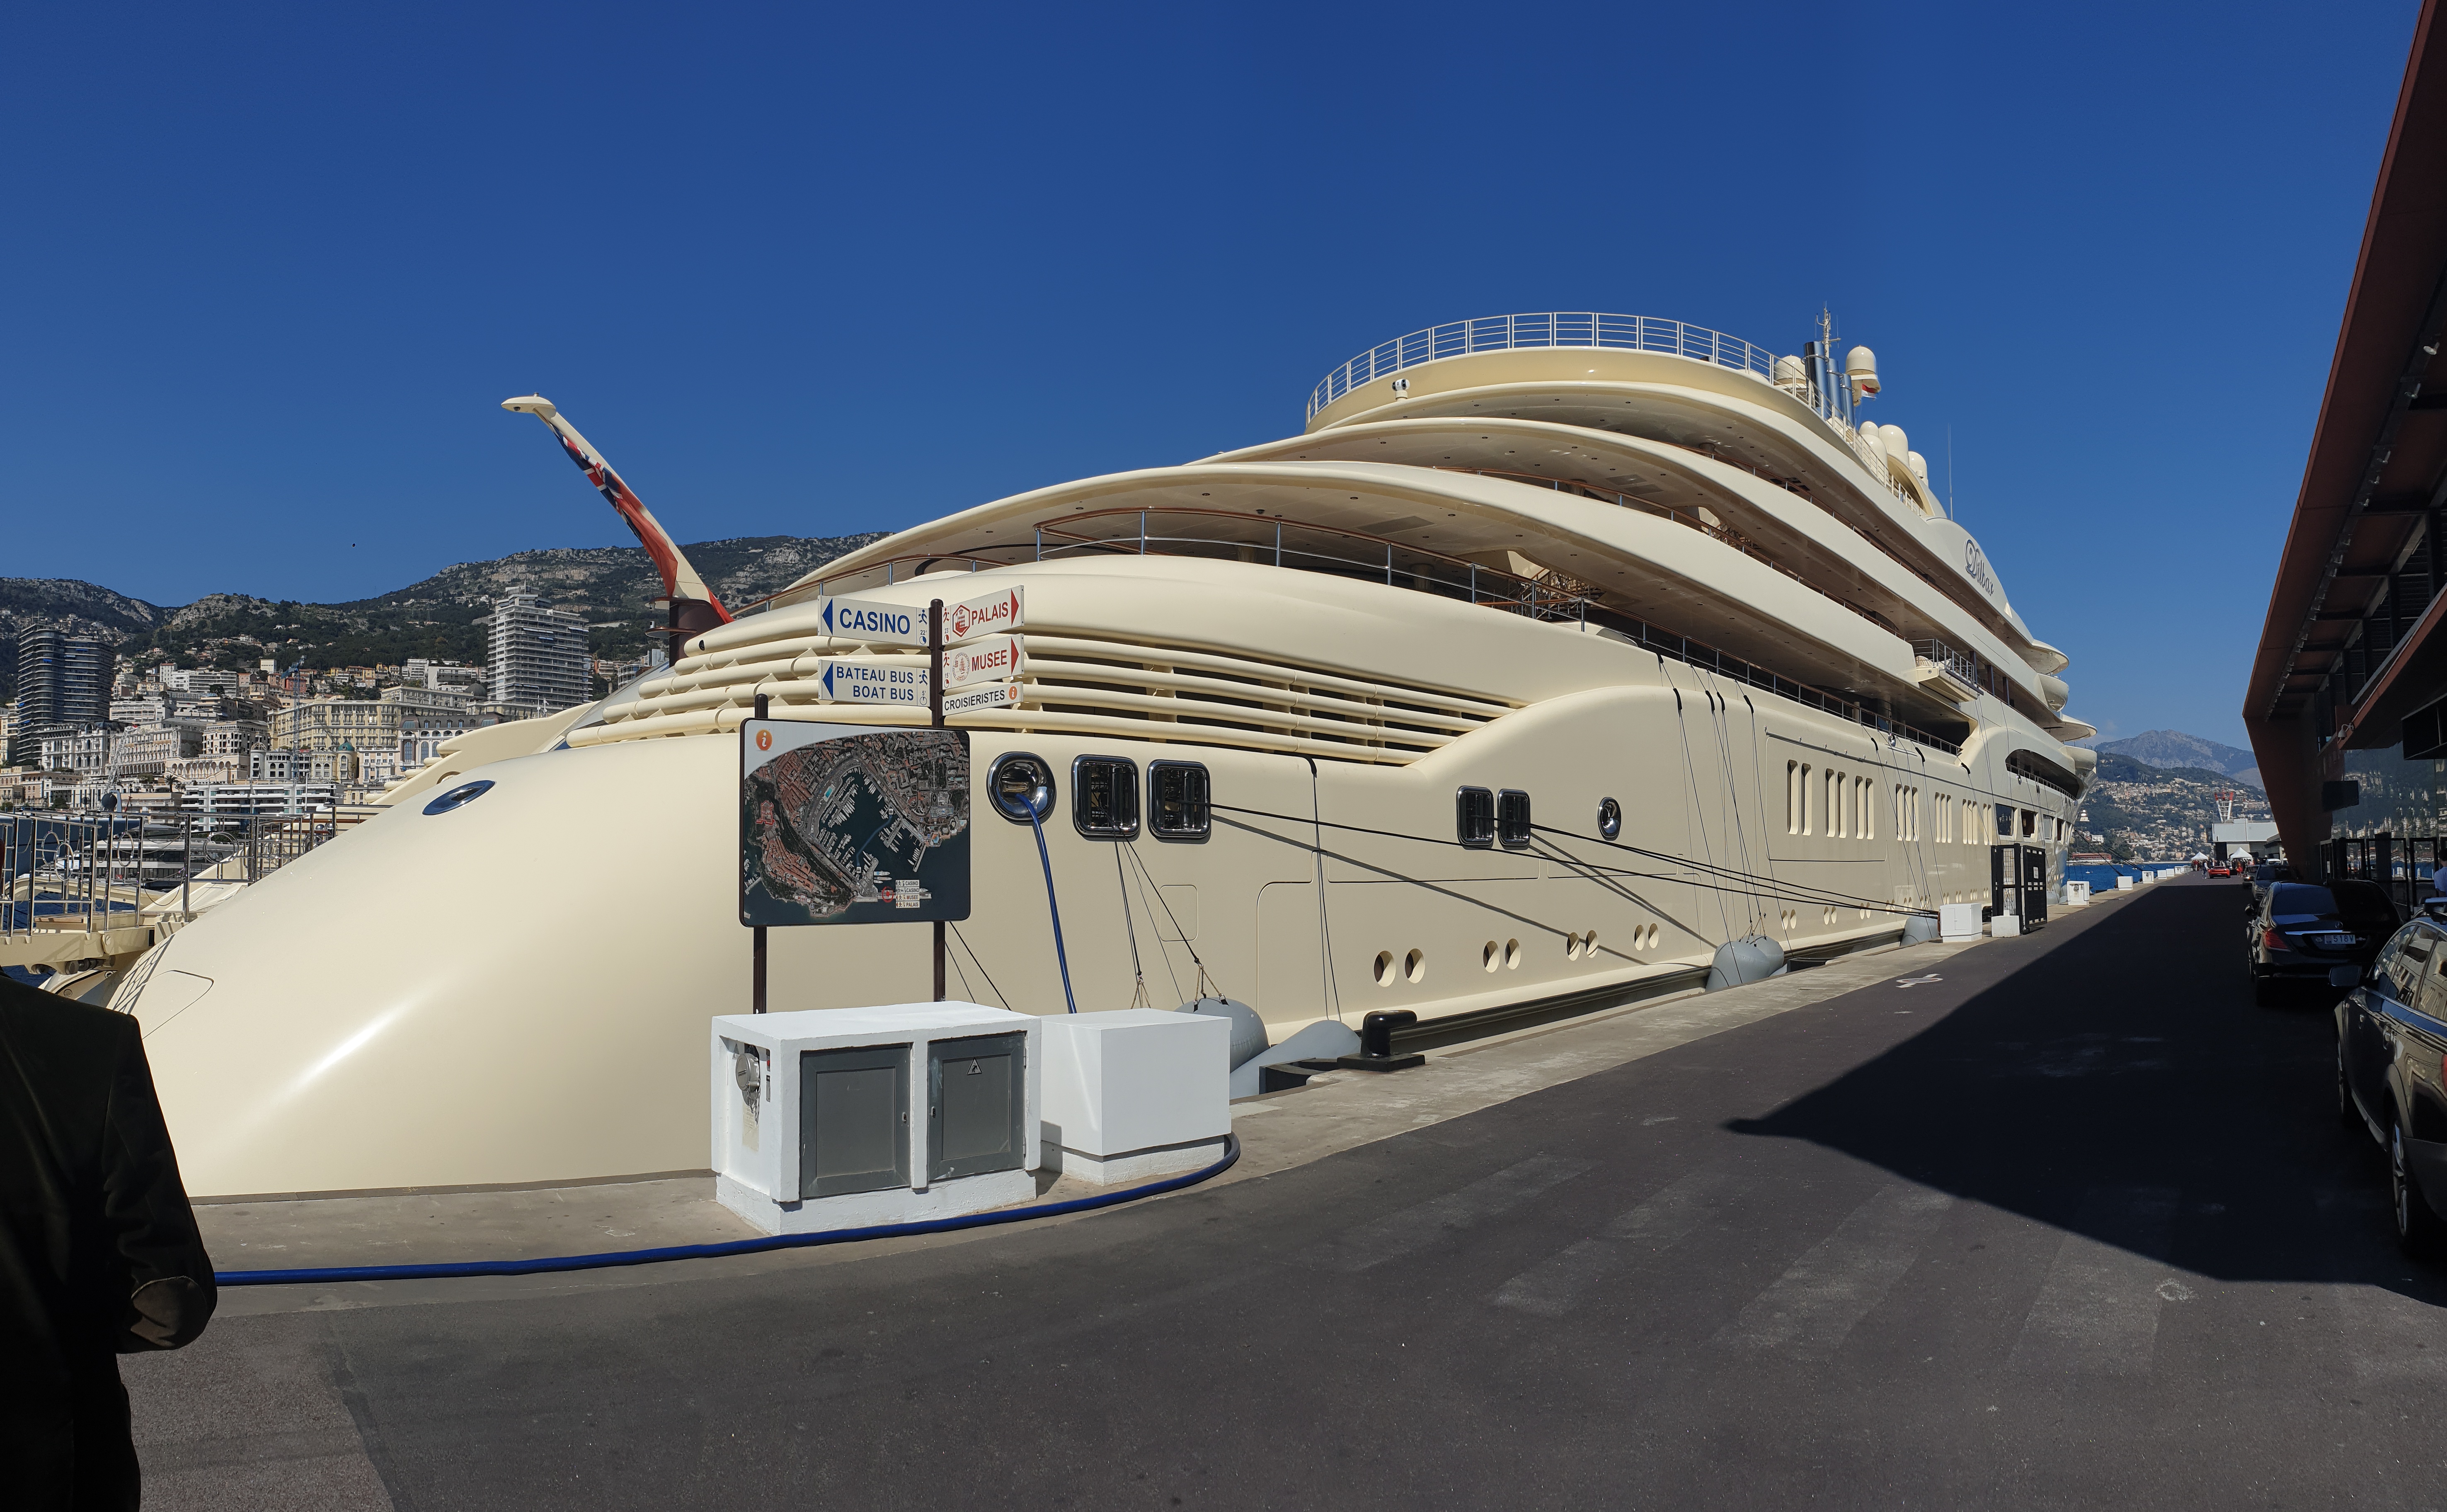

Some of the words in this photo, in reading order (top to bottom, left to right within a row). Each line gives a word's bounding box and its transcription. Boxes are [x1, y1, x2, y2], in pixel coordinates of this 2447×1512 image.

[1965, 539, 1994, 596] Dilbar
[839, 608, 910, 635] CASINO
[972, 601, 1008, 626] PALAIS
[972, 649, 1007, 672] MUSEE
[836, 666, 885, 682] BATEAU
[890, 671, 913, 684] BUS
[853, 685, 886, 699] BOAT
[890, 688, 914, 701] BUS
[944, 689, 1005, 711] CROISIERISTES
